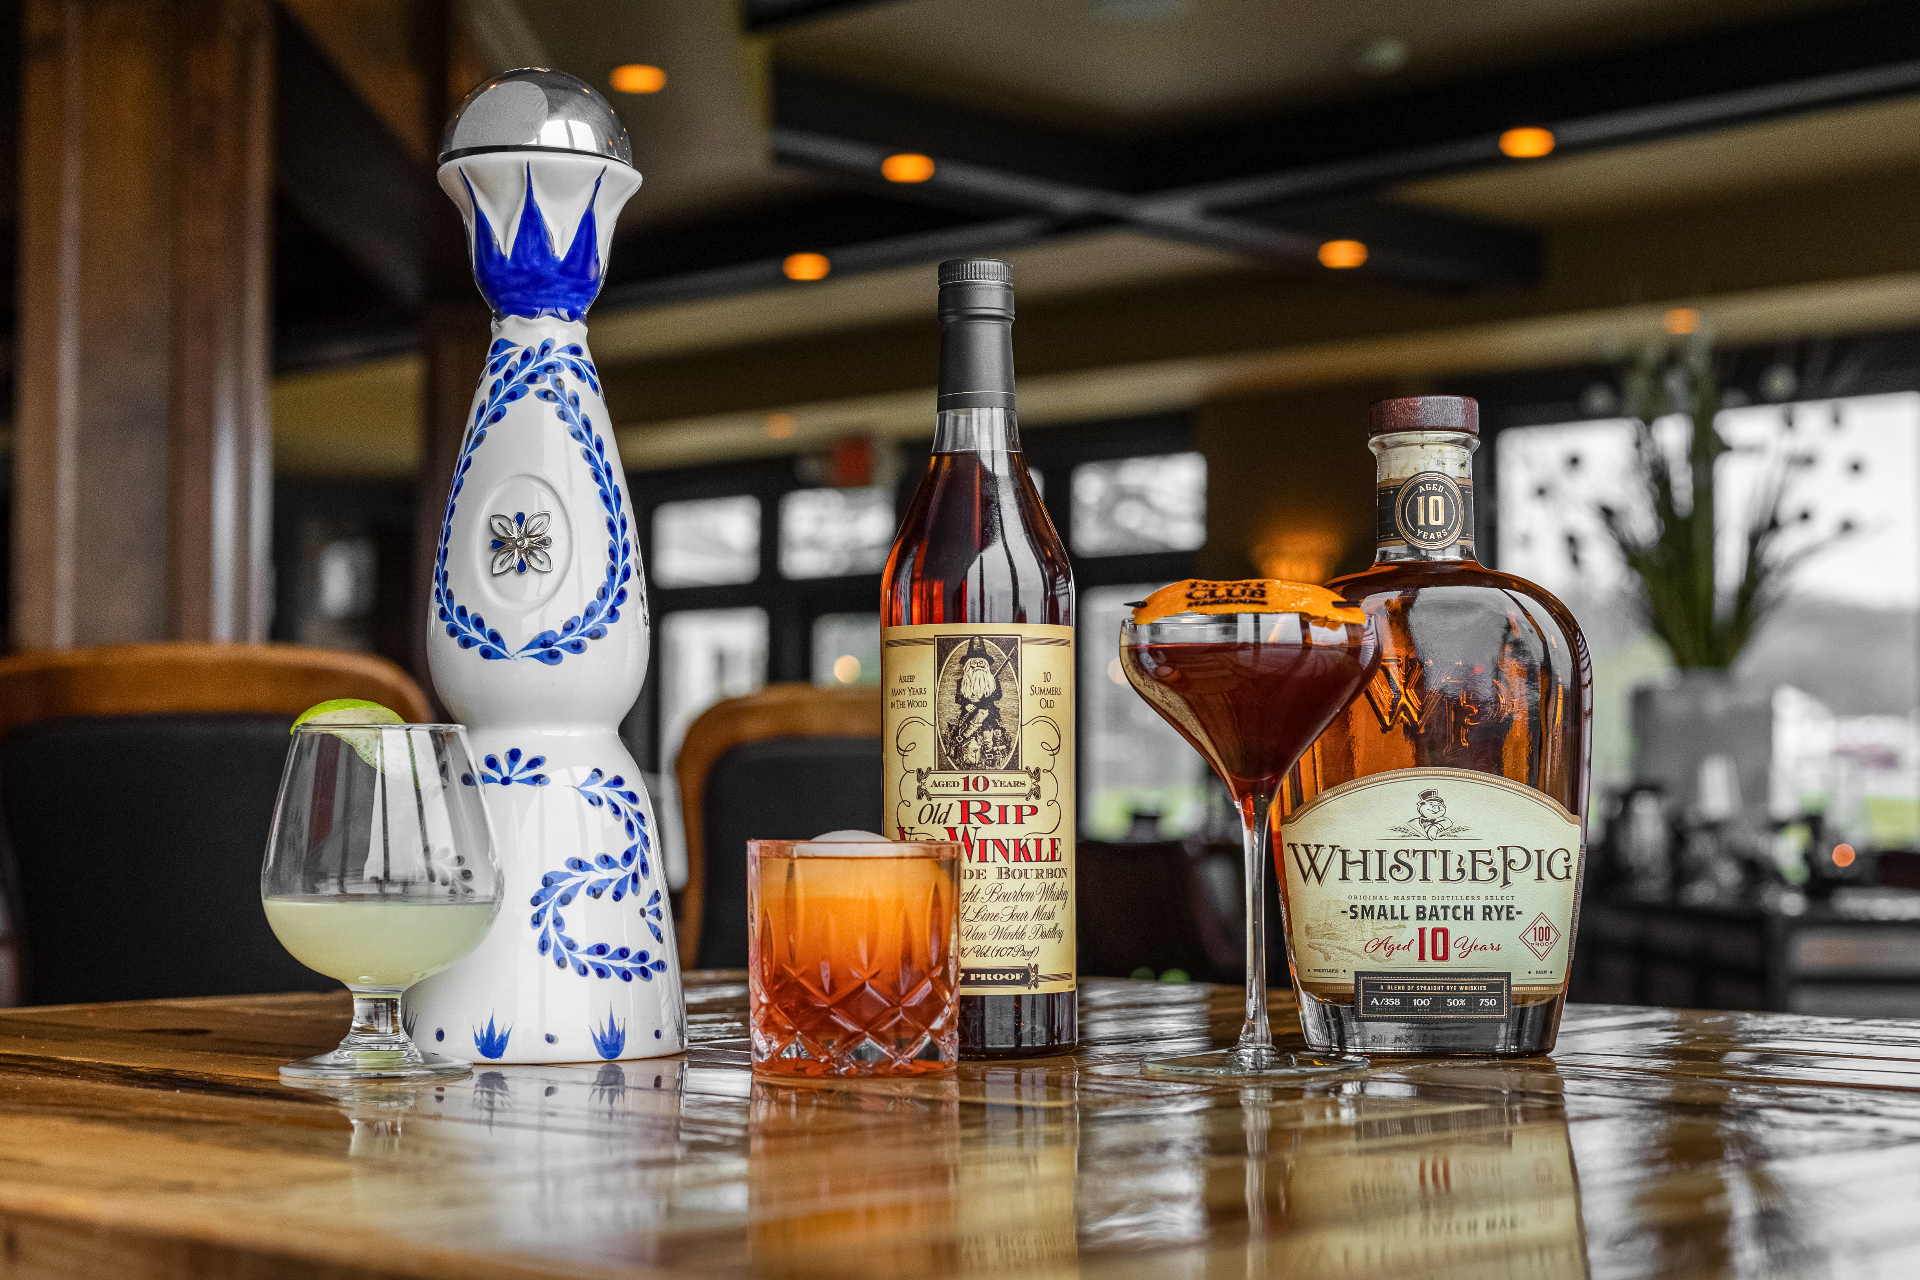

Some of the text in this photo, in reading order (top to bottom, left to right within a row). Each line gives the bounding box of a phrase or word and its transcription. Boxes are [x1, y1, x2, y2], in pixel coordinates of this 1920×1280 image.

[1419, 483, 1445, 493] AGED
[1416, 495, 1445, 526] 10
[1416, 528, 1448, 540] YEARS
[1042, 671, 1052, 683] 10
[1029, 685, 1062, 696] SUMMERS
[1039, 697, 1055, 709] OLD
[930, 775, 1027, 792] AGED 10 YEARS
[917, 799, 1039, 825] Old RIP
[980, 882, 1035, 904] Bourbon
[1000, 904, 1029, 923] Sour
[1029, 903, 1057, 922] Mash
[1416, 904, 1475, 921] BATCH
[962, 924, 988, 942] Van
[988, 924, 1029, 942] Winkle
[1533, 925, 1551, 942] 100
[1364, 926, 1502, 962] Aged 10 Years
[970, 973, 1024, 981] PROOF
[1446, 998, 1466, 1007] 50%
[1479, 998, 1497, 1007] 750
